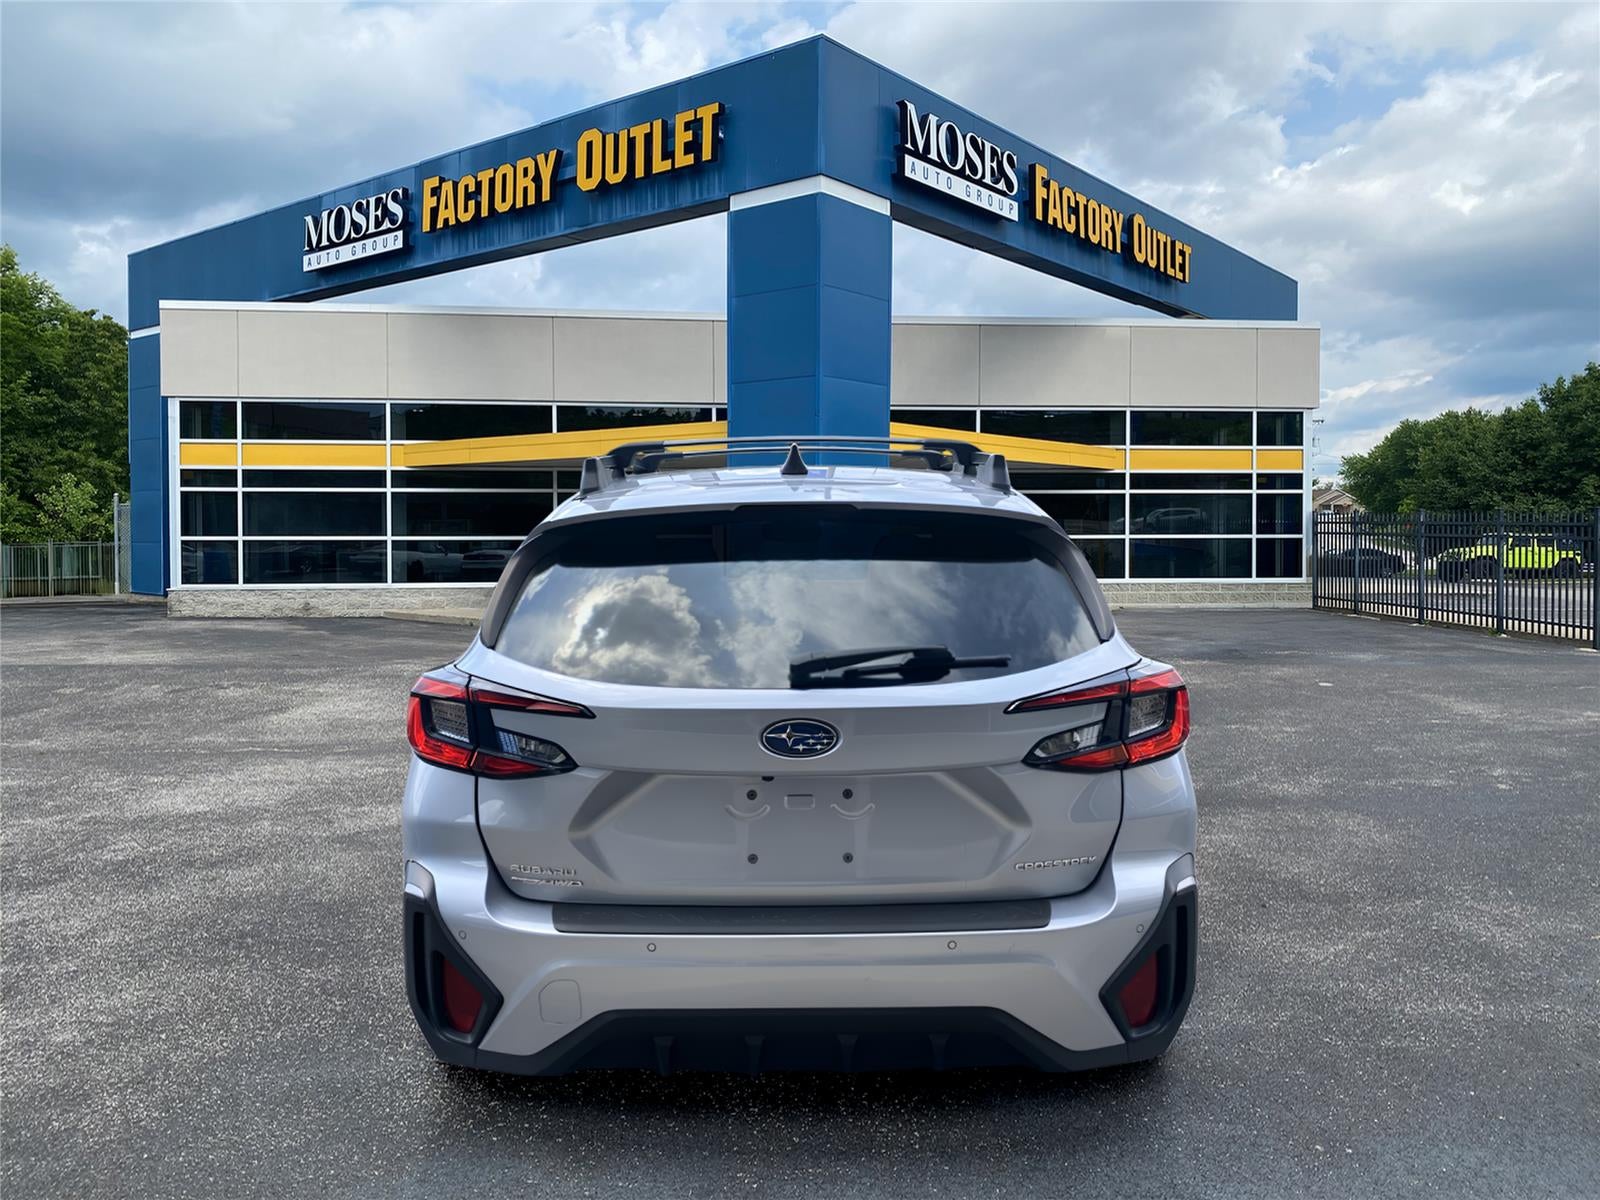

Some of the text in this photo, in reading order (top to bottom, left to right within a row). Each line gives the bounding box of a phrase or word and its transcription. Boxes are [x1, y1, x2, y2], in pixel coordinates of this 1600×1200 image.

[422, 102, 720, 233] FACTORY OUTLET
[903, 100, 1018, 196] MOSES
[910, 161, 1014, 214] AUTO GROUP
[303, 187, 404, 251] MOSES
[1035, 163, 1192, 283] FACTORY OUTLET
[307, 234, 399, 267] AUTO GROUP
[510, 864, 577, 877] SUBARU
[1014, 856, 1097, 871] CROSSTREK
